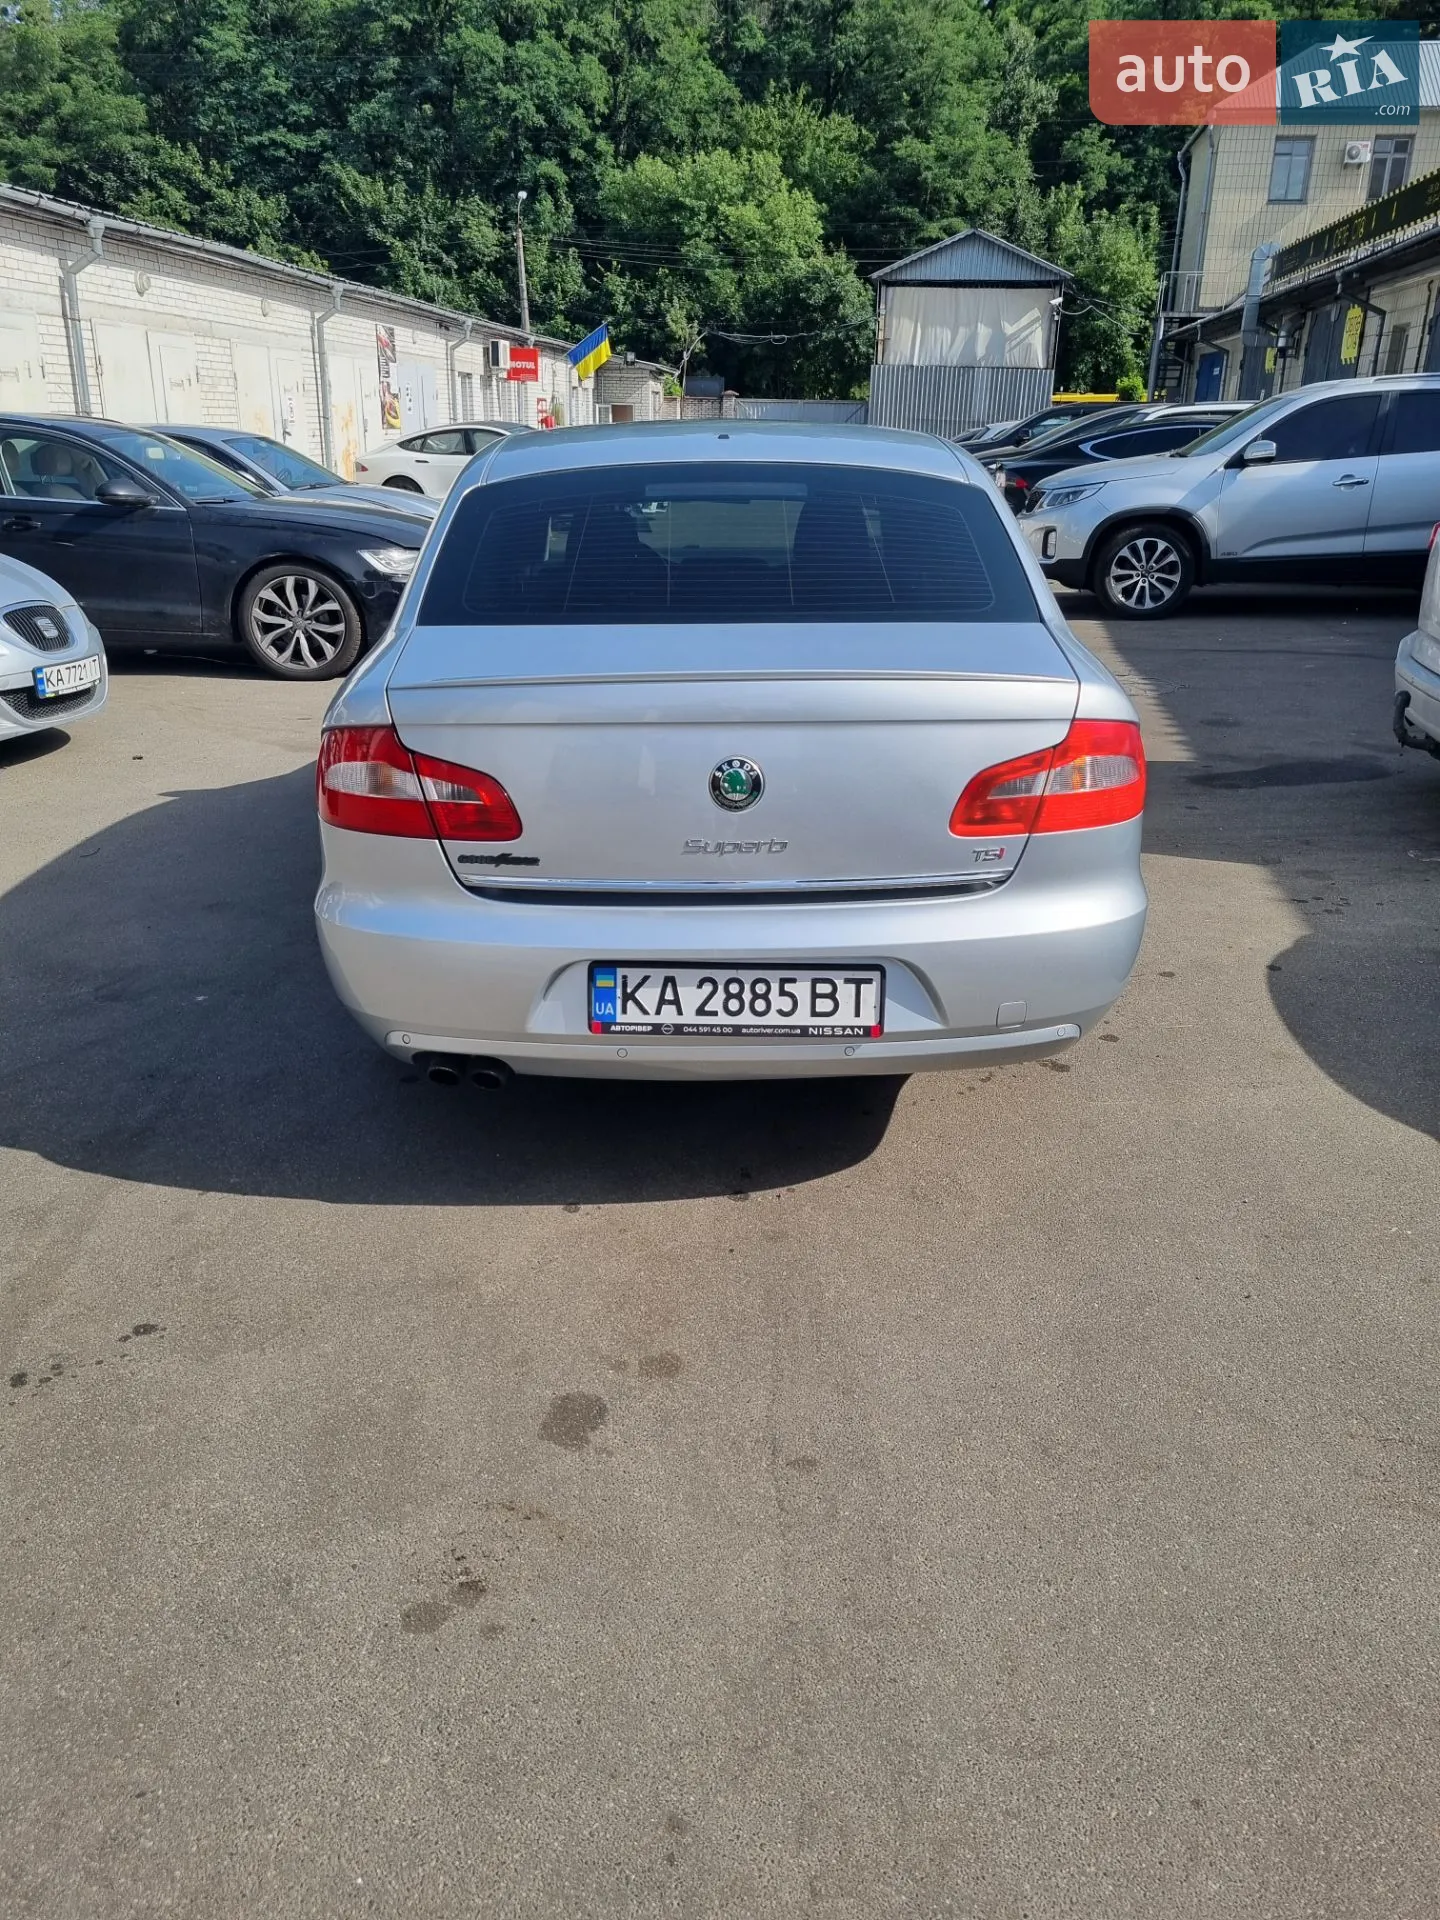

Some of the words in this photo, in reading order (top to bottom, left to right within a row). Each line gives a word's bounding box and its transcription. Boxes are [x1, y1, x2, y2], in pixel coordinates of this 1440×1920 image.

[45, 667, 65, 689] KA
[66, 662, 88, 685] 7721
[680, 838, 789, 857] Superb
[620, 974, 684, 1017] KA
[694, 976, 799, 1018] 2885
[809, 977, 875, 1019] BT
[595, 1002, 614, 1016] UA
[683, 1026, 698, 1034] 044
[698, 1026, 712, 1034] 591
[713, 1026, 723, 1034] 45
[724, 1026, 734, 1034] 00
[741, 1026, 801, 1035] autoriver.com.ua
[808, 1026, 864, 1036] NISSAN
